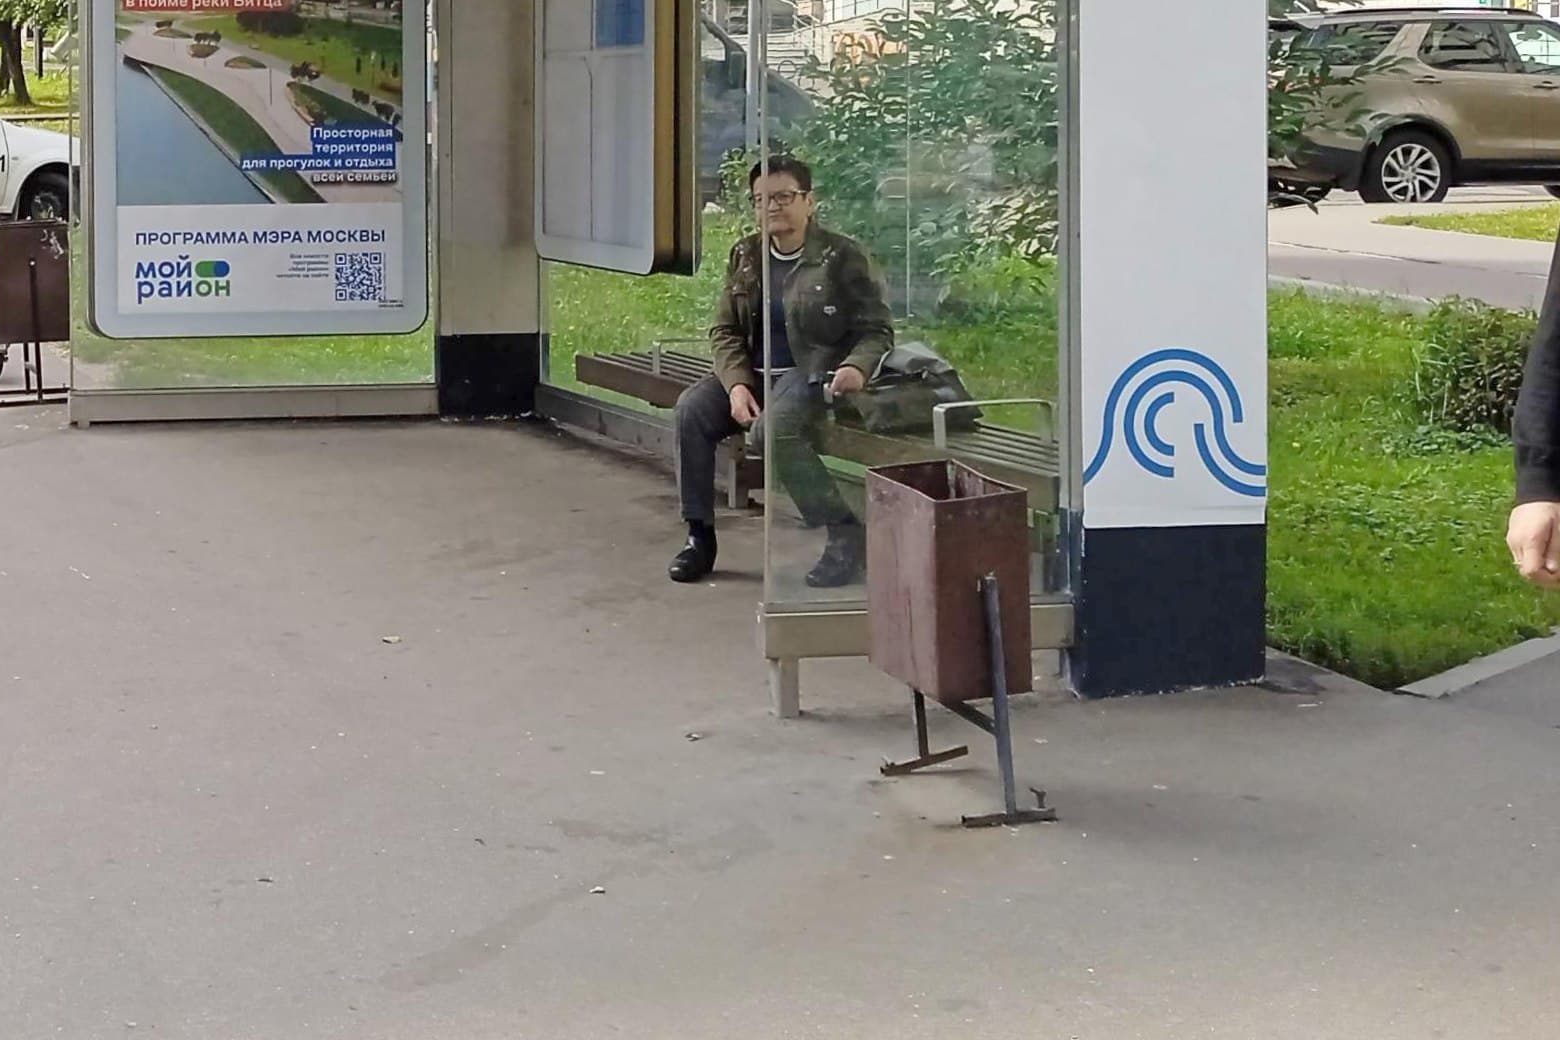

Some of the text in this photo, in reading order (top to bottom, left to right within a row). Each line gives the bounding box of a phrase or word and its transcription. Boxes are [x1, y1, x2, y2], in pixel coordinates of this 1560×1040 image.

[312, 127, 393, 140] Просторная
[314, 144, 393, 155] территория
[241, 157, 393, 170] для прогулок и отдыха
[135, 230, 385, 245] ПРОГРАММА МЭРА МОСКВЫ
[135, 254, 191, 279] мой
